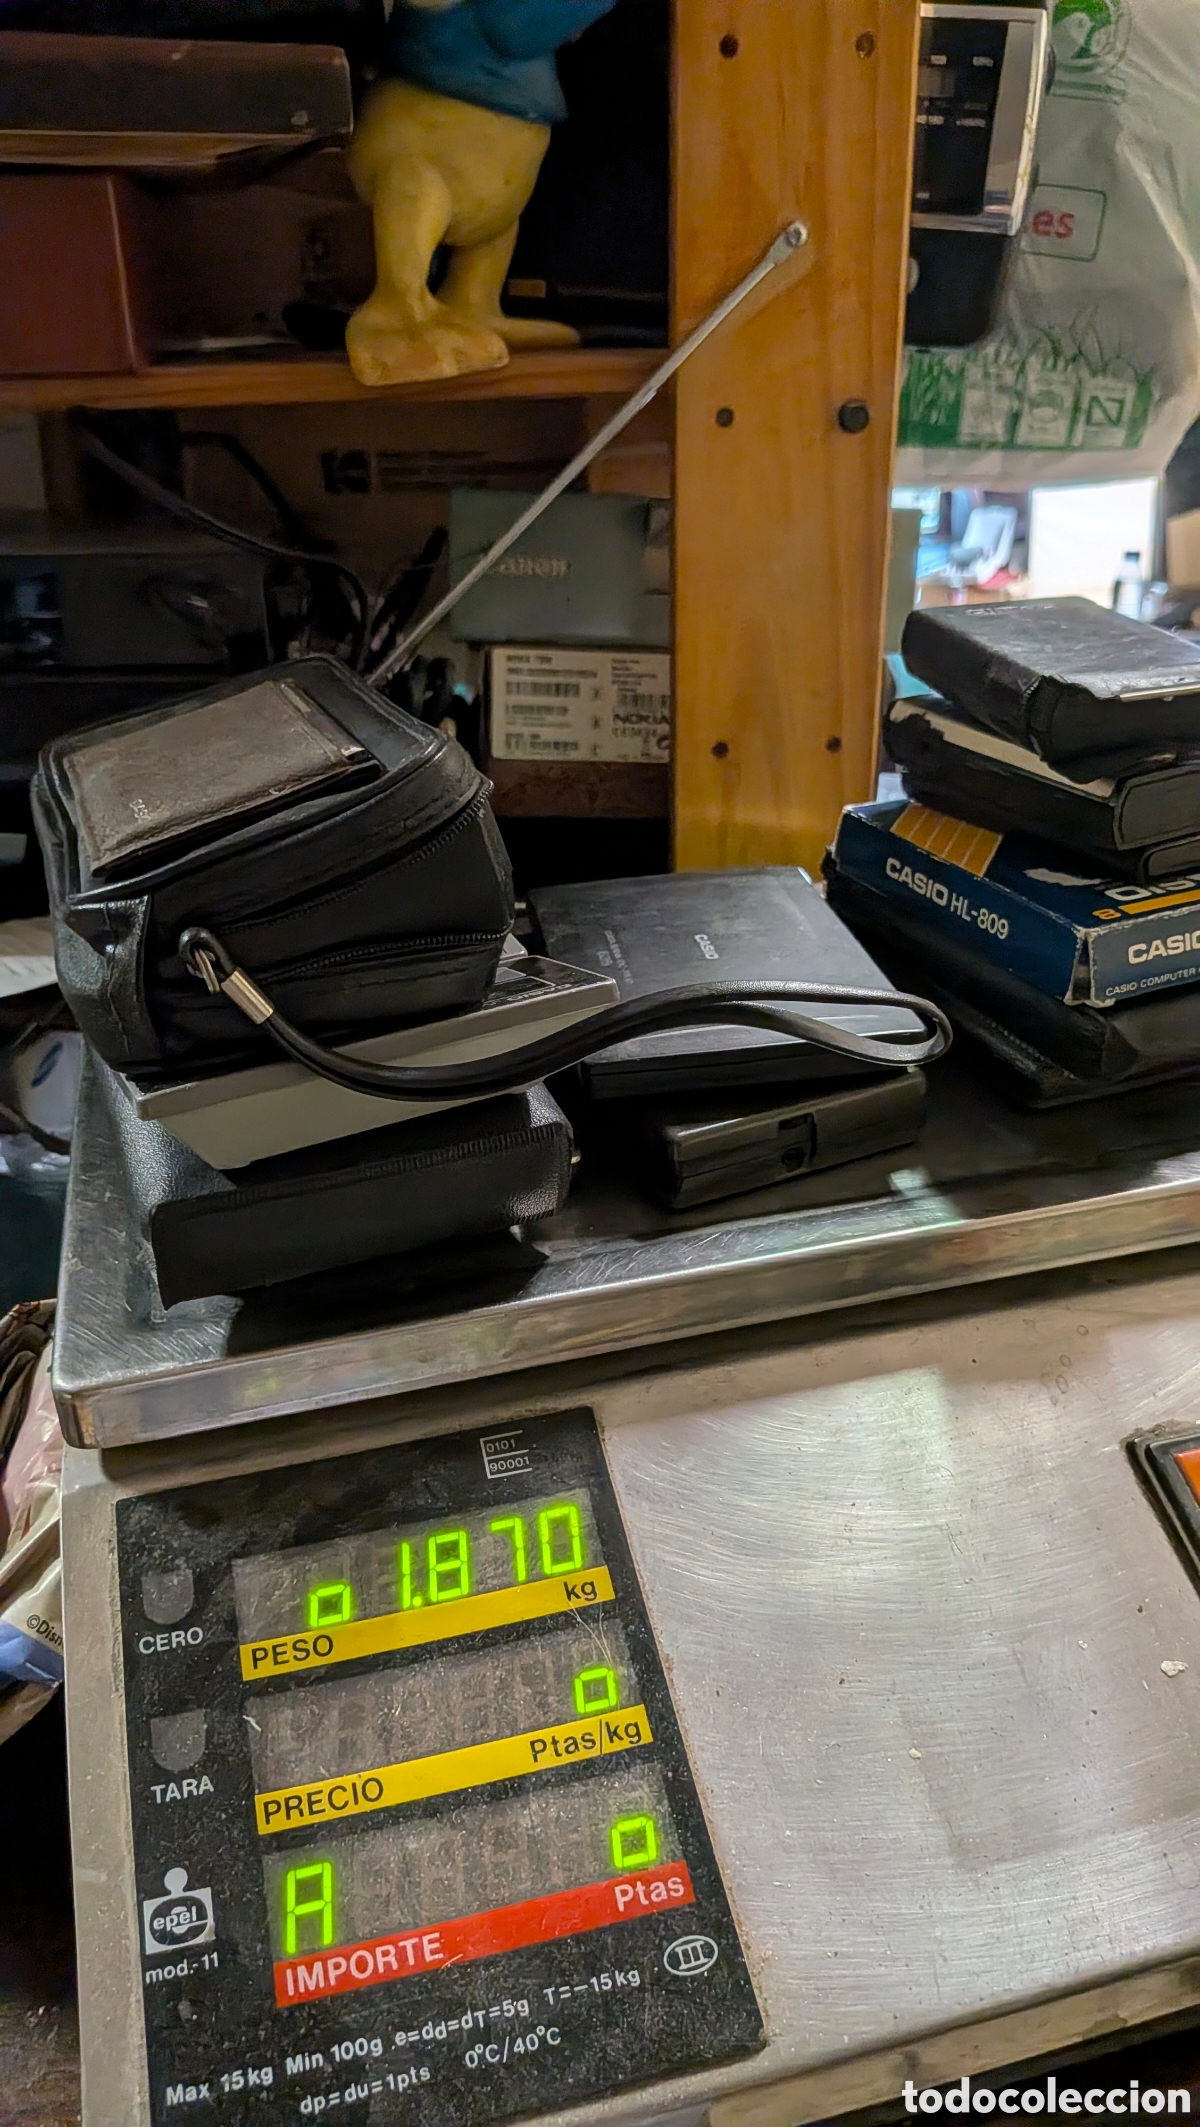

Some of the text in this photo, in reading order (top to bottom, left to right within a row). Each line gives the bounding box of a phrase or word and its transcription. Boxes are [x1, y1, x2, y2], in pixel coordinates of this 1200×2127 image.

[886, 857, 1009, 940] CASIO HL-809
[1105, 967, 1196, 996] CASIO COMPUTER
[486, 1438, 516, 1453] 0101
[489, 1456, 530, 1472] 90001
[563, 1580, 598, 1602] kg
[139, 1627, 204, 1654] CERO
[250, 1634, 335, 1672] PESO
[529, 1718, 644, 1764] Ptas/kg
[150, 1775, 215, 1804] TARA
[262, 1777, 385, 1827] PRECIO
[285, 1860, 334, 1955] A
[612, 1874, 686, 1912] Ptas
[152, 1904, 198, 1934] epel
[284, 1934, 446, 1996] IMPORTE
[166, 2081, 211, 2107] Max
[285, 2052, 324, 2077] Min
[330, 2036, 384, 2063] 100g
